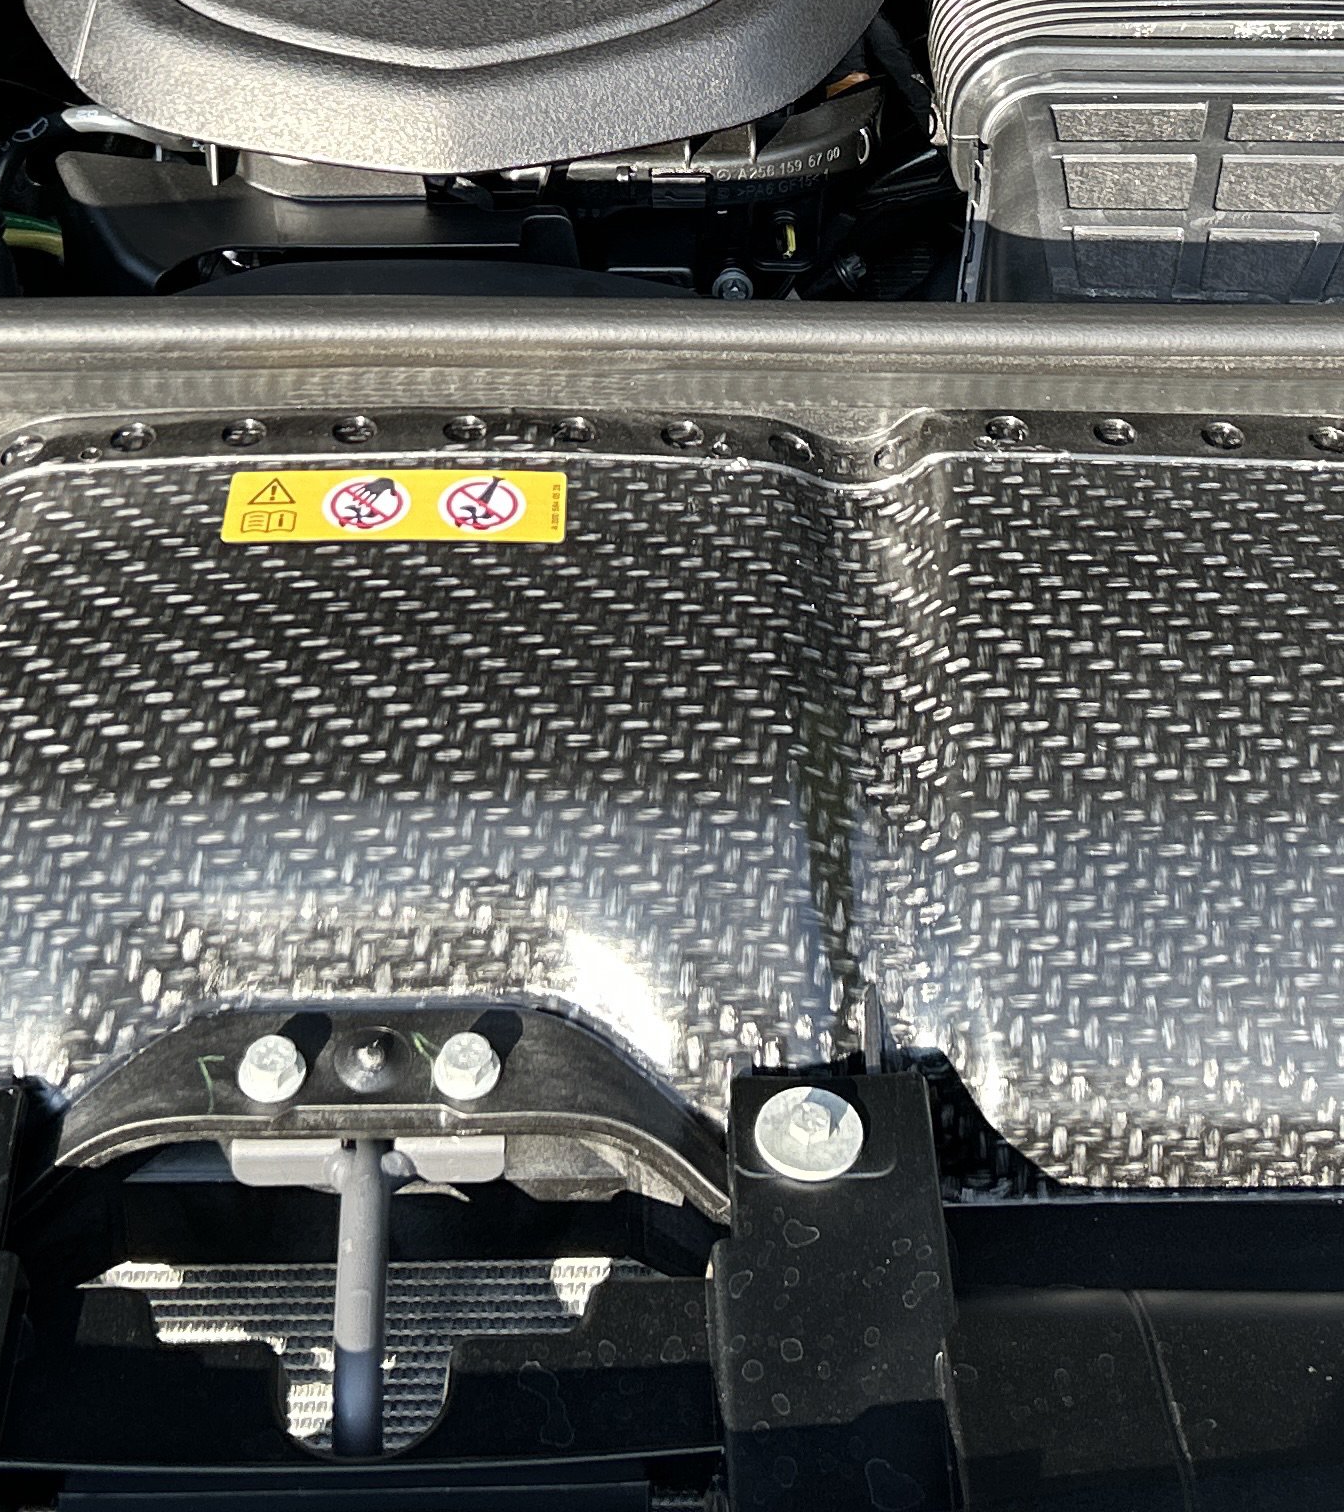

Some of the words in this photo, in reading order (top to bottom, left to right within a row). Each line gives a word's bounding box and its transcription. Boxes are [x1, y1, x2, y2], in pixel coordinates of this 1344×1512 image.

[779, 160, 803, 176] 159
[808, 154, 823, 168] 67
[826, 146, 841, 162] 00
